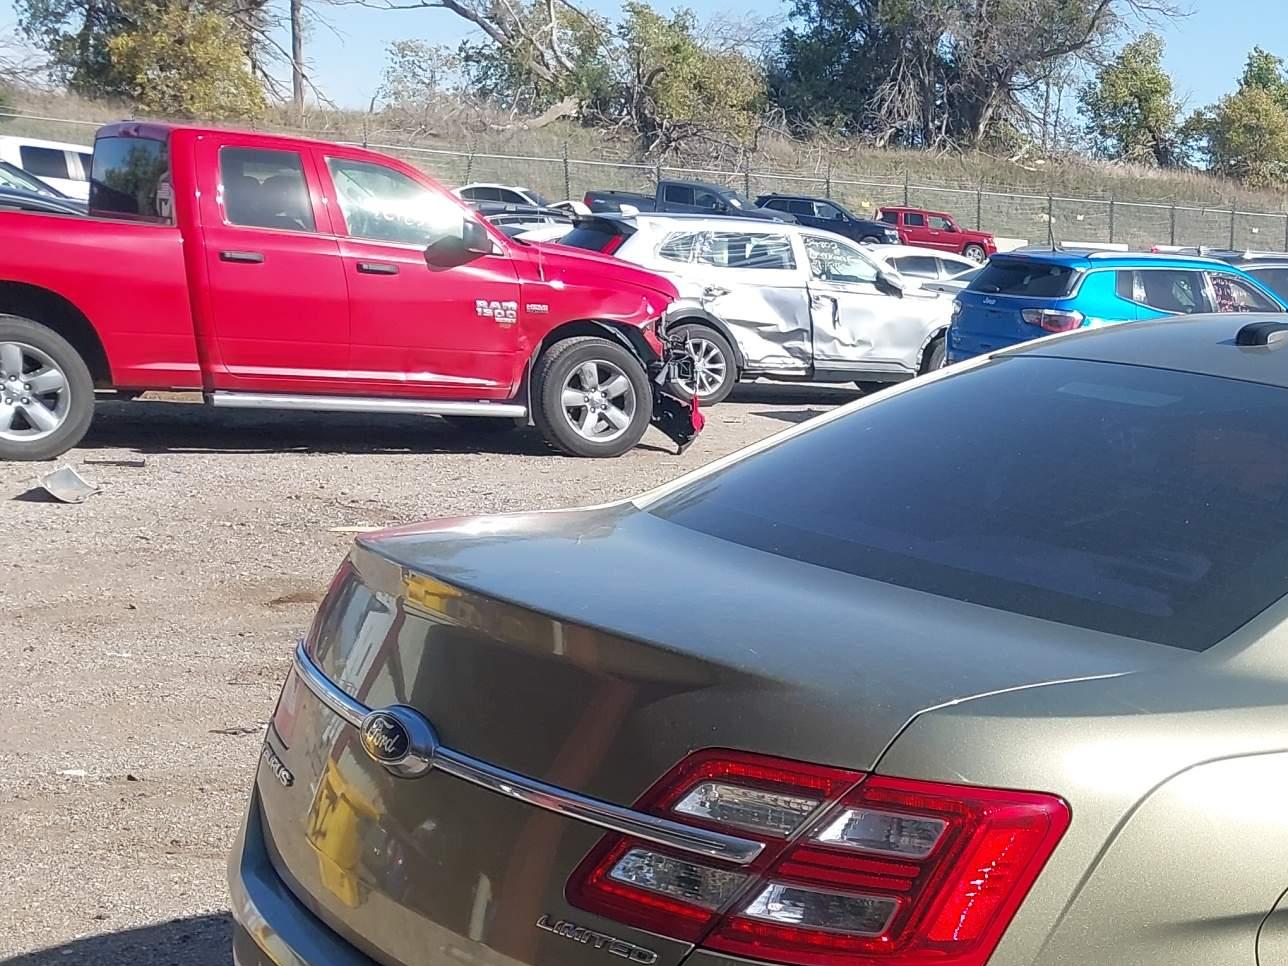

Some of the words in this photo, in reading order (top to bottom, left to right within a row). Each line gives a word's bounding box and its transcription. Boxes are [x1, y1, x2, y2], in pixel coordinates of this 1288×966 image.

[475, 300, 518, 310] RAM
[475, 307, 517, 318] 1500
[366, 717, 400, 753] Ford
[536, 914, 657, 964] LIMITED
